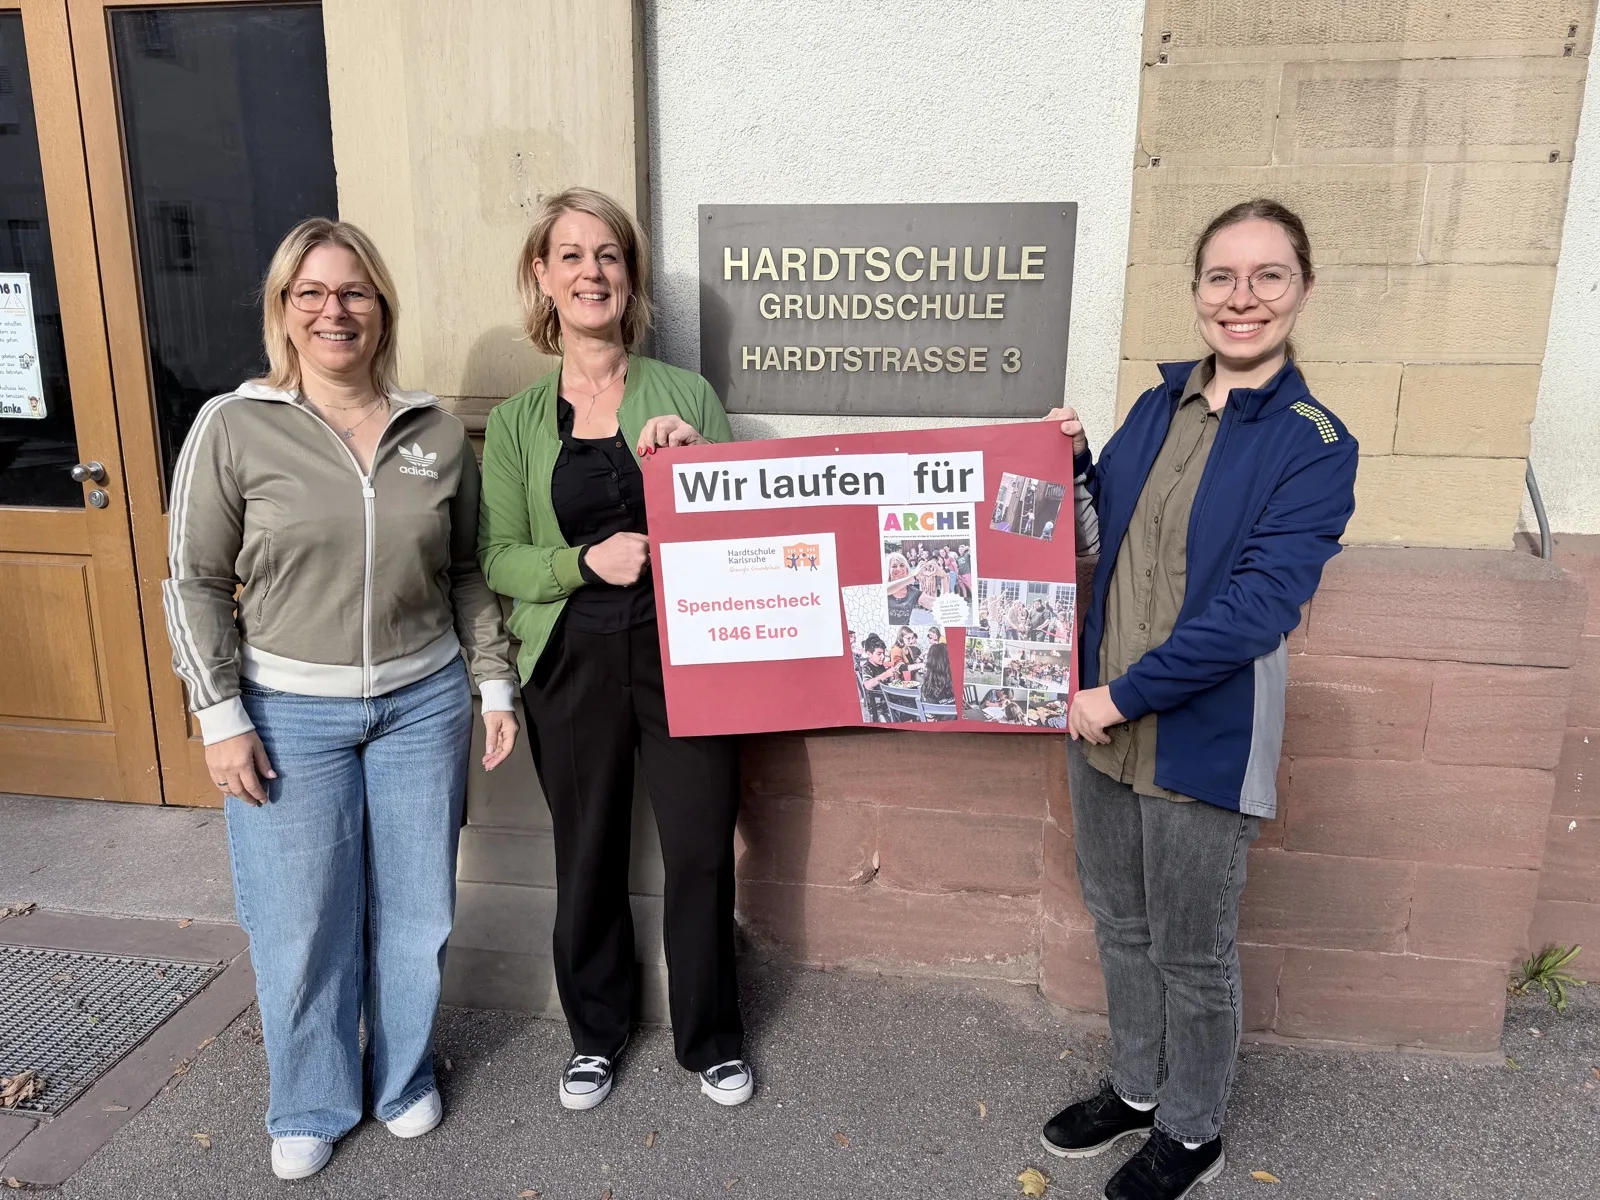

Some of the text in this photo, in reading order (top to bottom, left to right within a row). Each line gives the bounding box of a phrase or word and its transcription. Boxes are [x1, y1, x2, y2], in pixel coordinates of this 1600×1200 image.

[722, 245, 1048, 283] HARDTSCHULE
[758, 293, 1006, 321] GRUNDSCHULE
[741, 346, 1022, 374] HARDTSTRASSE 3
[399, 465, 439, 480] adidas
[678, 461, 975, 504] Wir laufen für
[883, 511, 970, 532] ARCHE
[727, 547, 776, 557] Hardtschule
[728, 556, 767, 565] Karlsruhe
[676, 592, 821, 616] Spendenscheck
[707, 625, 799, 642] 1846 Euro
